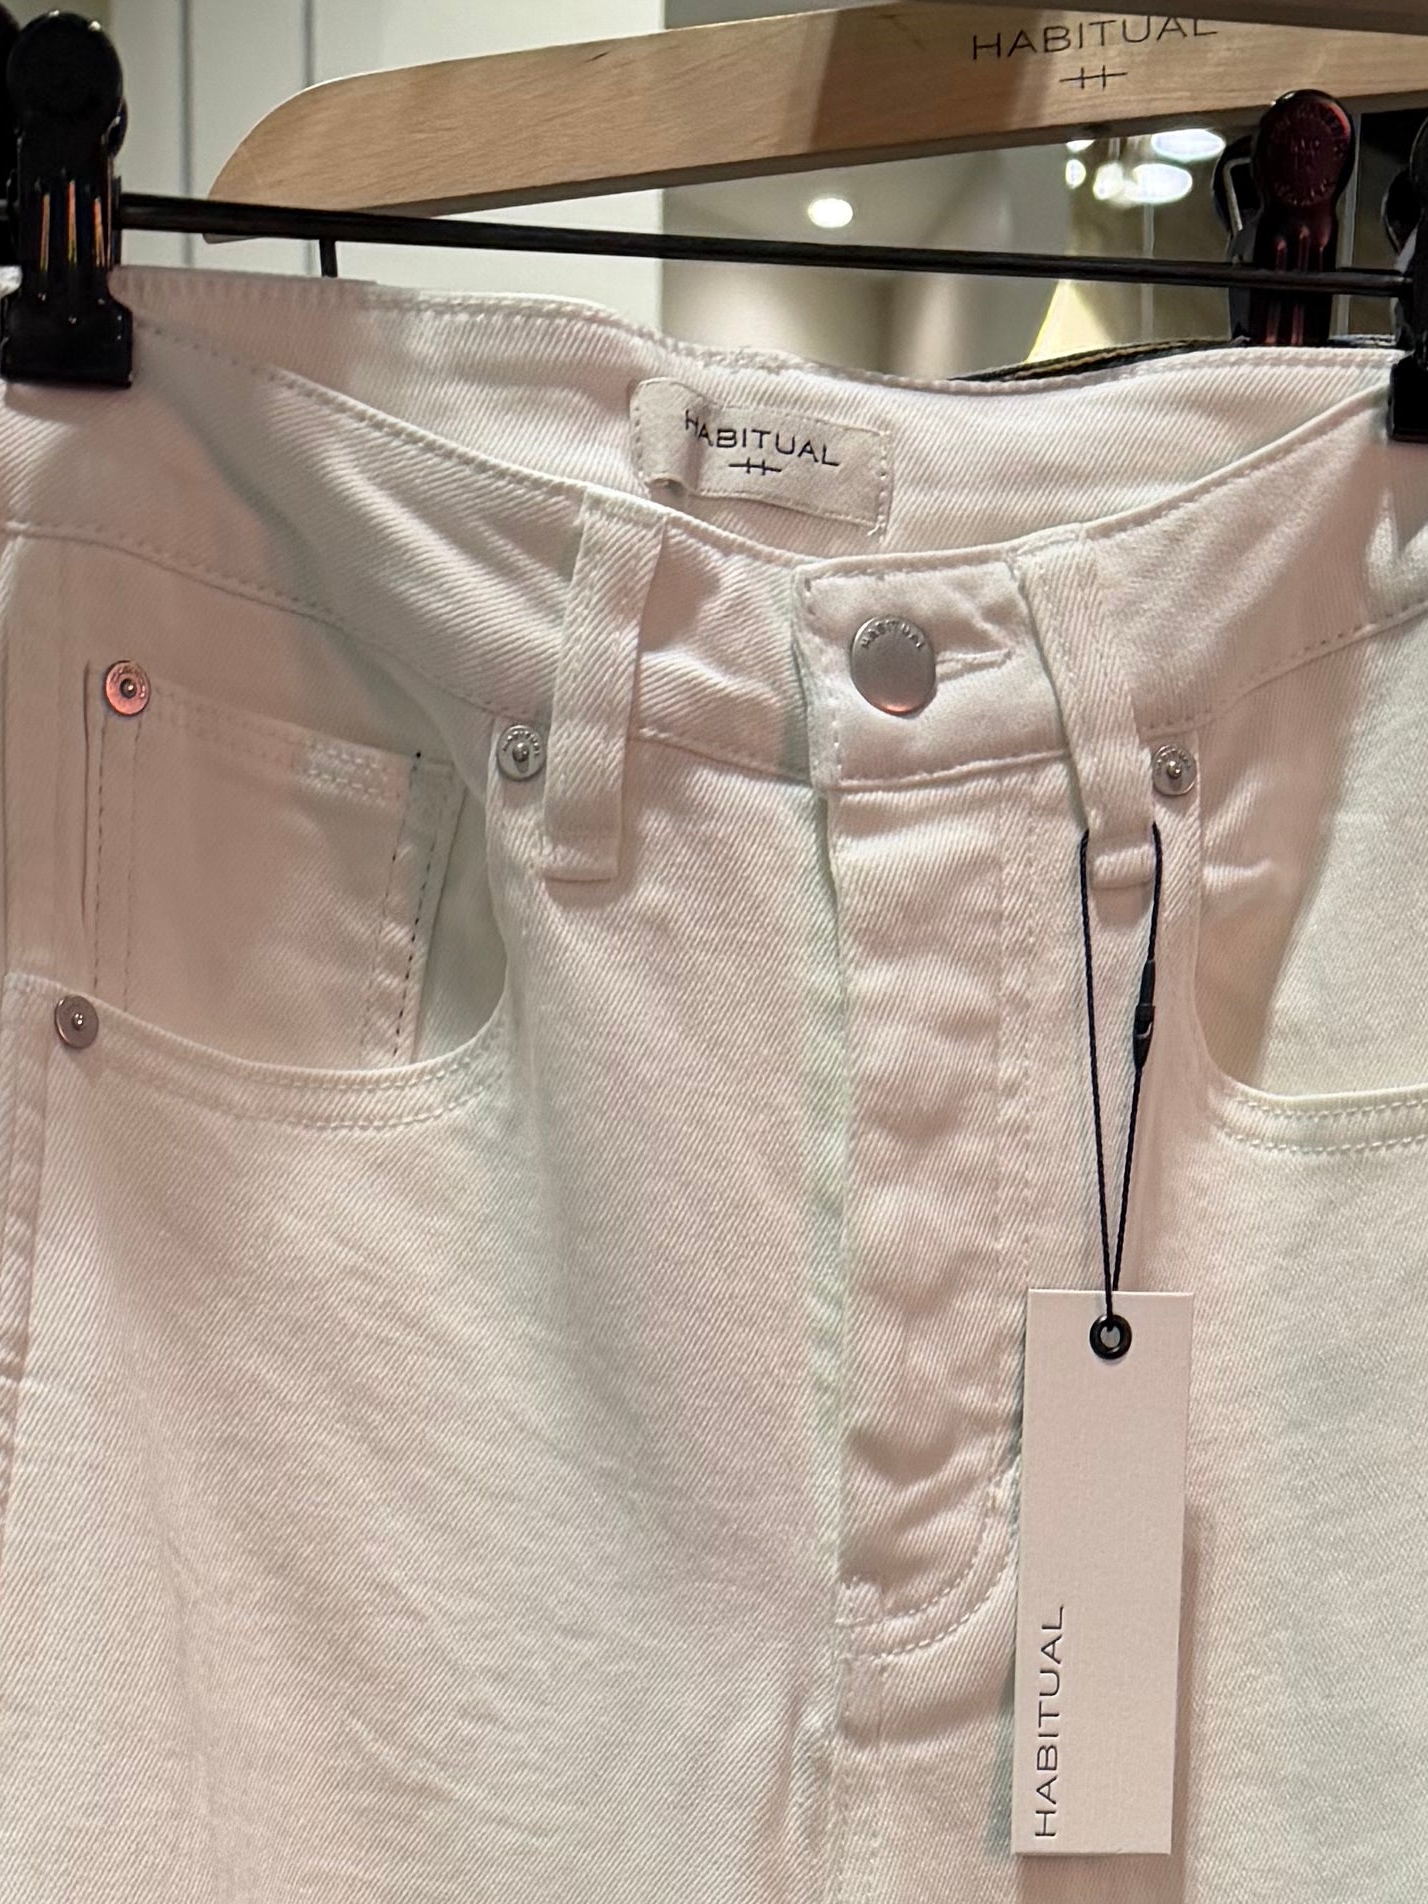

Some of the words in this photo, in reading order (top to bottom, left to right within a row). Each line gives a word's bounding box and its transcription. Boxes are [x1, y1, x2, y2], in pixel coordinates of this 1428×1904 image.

[972, 15, 1219, 60] HABITUAL
[684, 409, 840, 467] HABITUAL
[1034, 1605, 1065, 1838] HABITUAL
